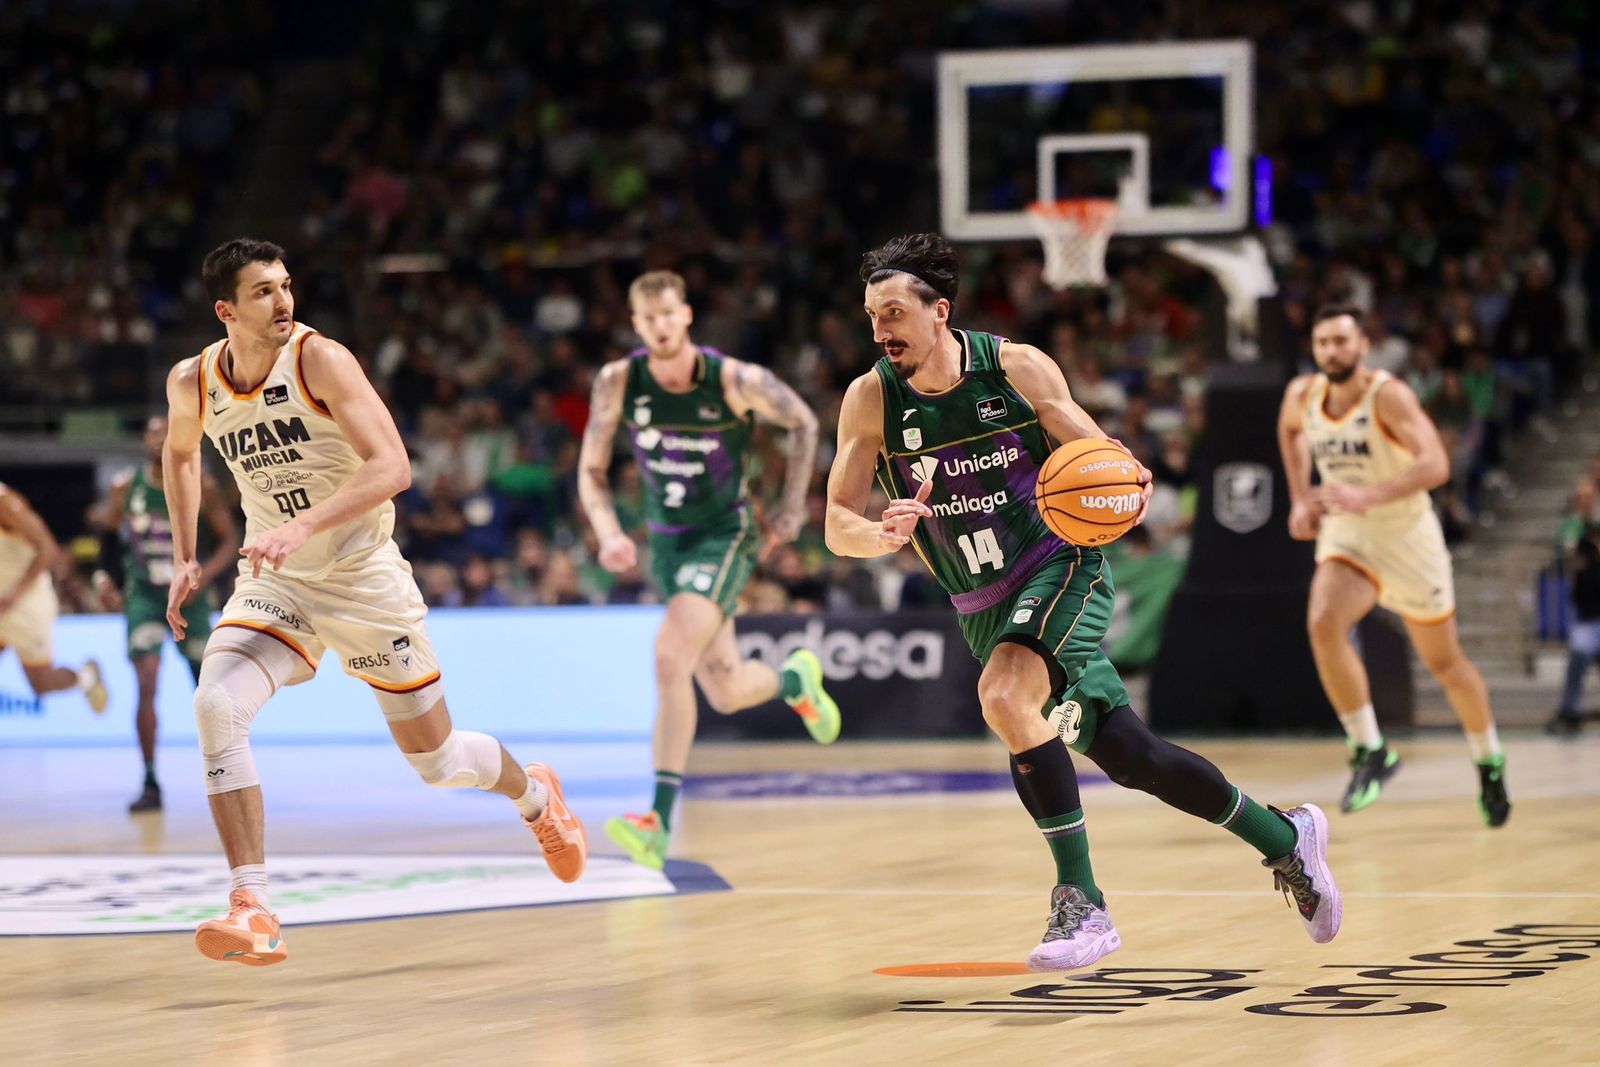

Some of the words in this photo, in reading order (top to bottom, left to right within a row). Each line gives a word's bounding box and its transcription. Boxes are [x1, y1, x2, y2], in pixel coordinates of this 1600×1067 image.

[219, 417, 312, 462] UCAM
[240, 448, 304, 474] MURCIA
[943, 445, 1020, 478] Unicaja
[272, 487, 312, 519] 90
[664, 481, 687, 508] 2
[1079, 491, 1141, 515] Wilson
[957, 527, 1006, 576] 14
[243, 599, 302, 630] INVERSUS
